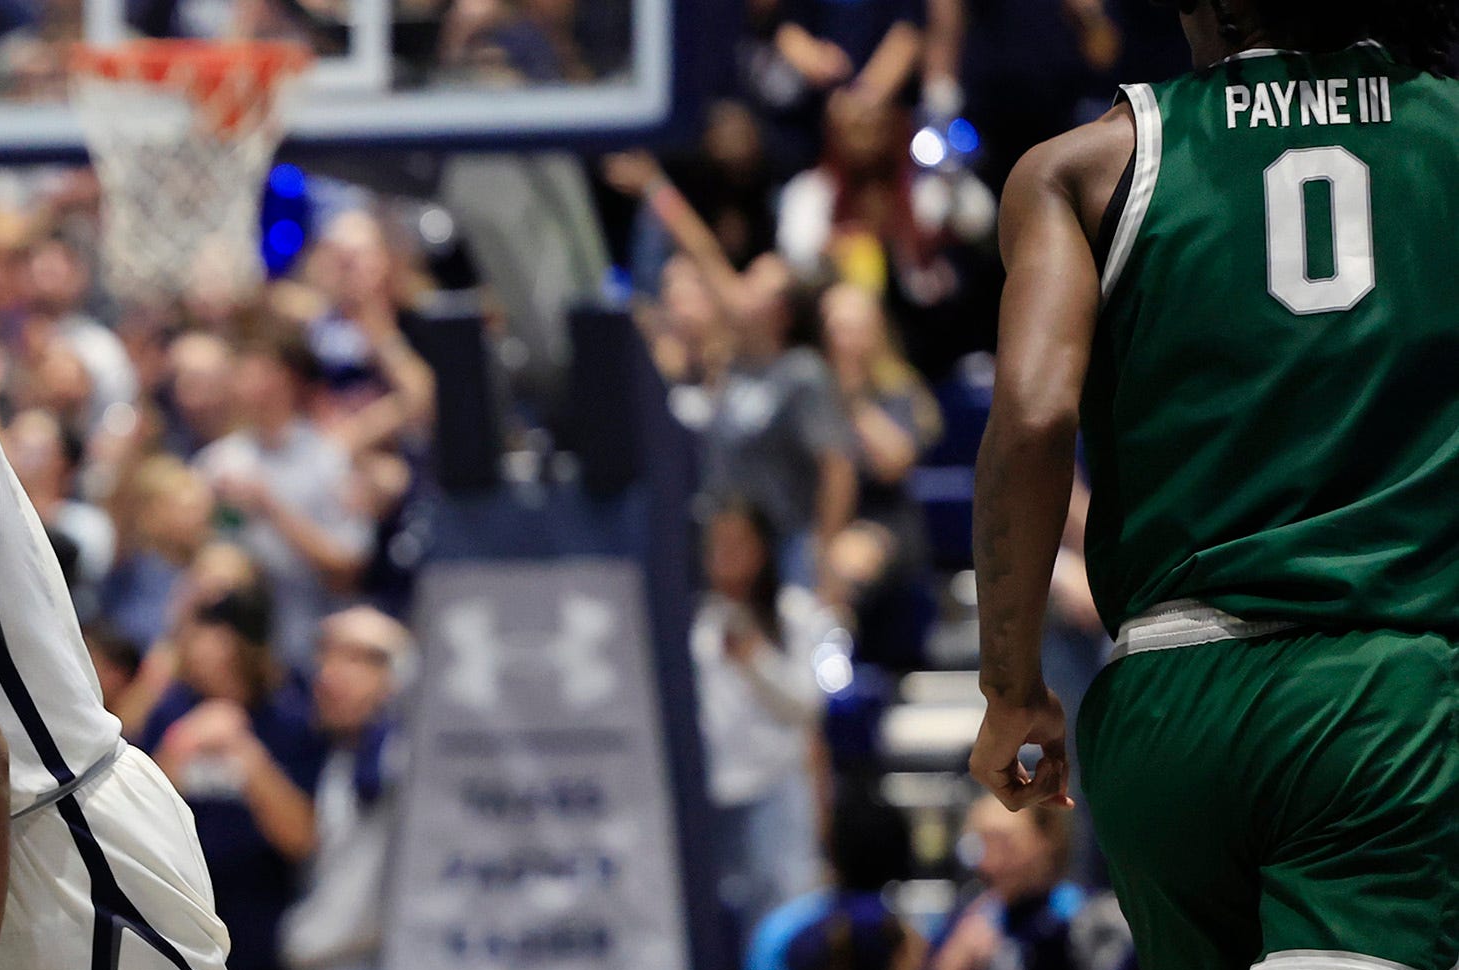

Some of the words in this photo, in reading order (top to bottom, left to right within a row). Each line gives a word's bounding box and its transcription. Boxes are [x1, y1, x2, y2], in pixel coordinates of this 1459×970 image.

[1225, 79, 1351, 129] PAYNE
[1357, 76, 1391, 123] III
[1263, 145, 1375, 315] 0
